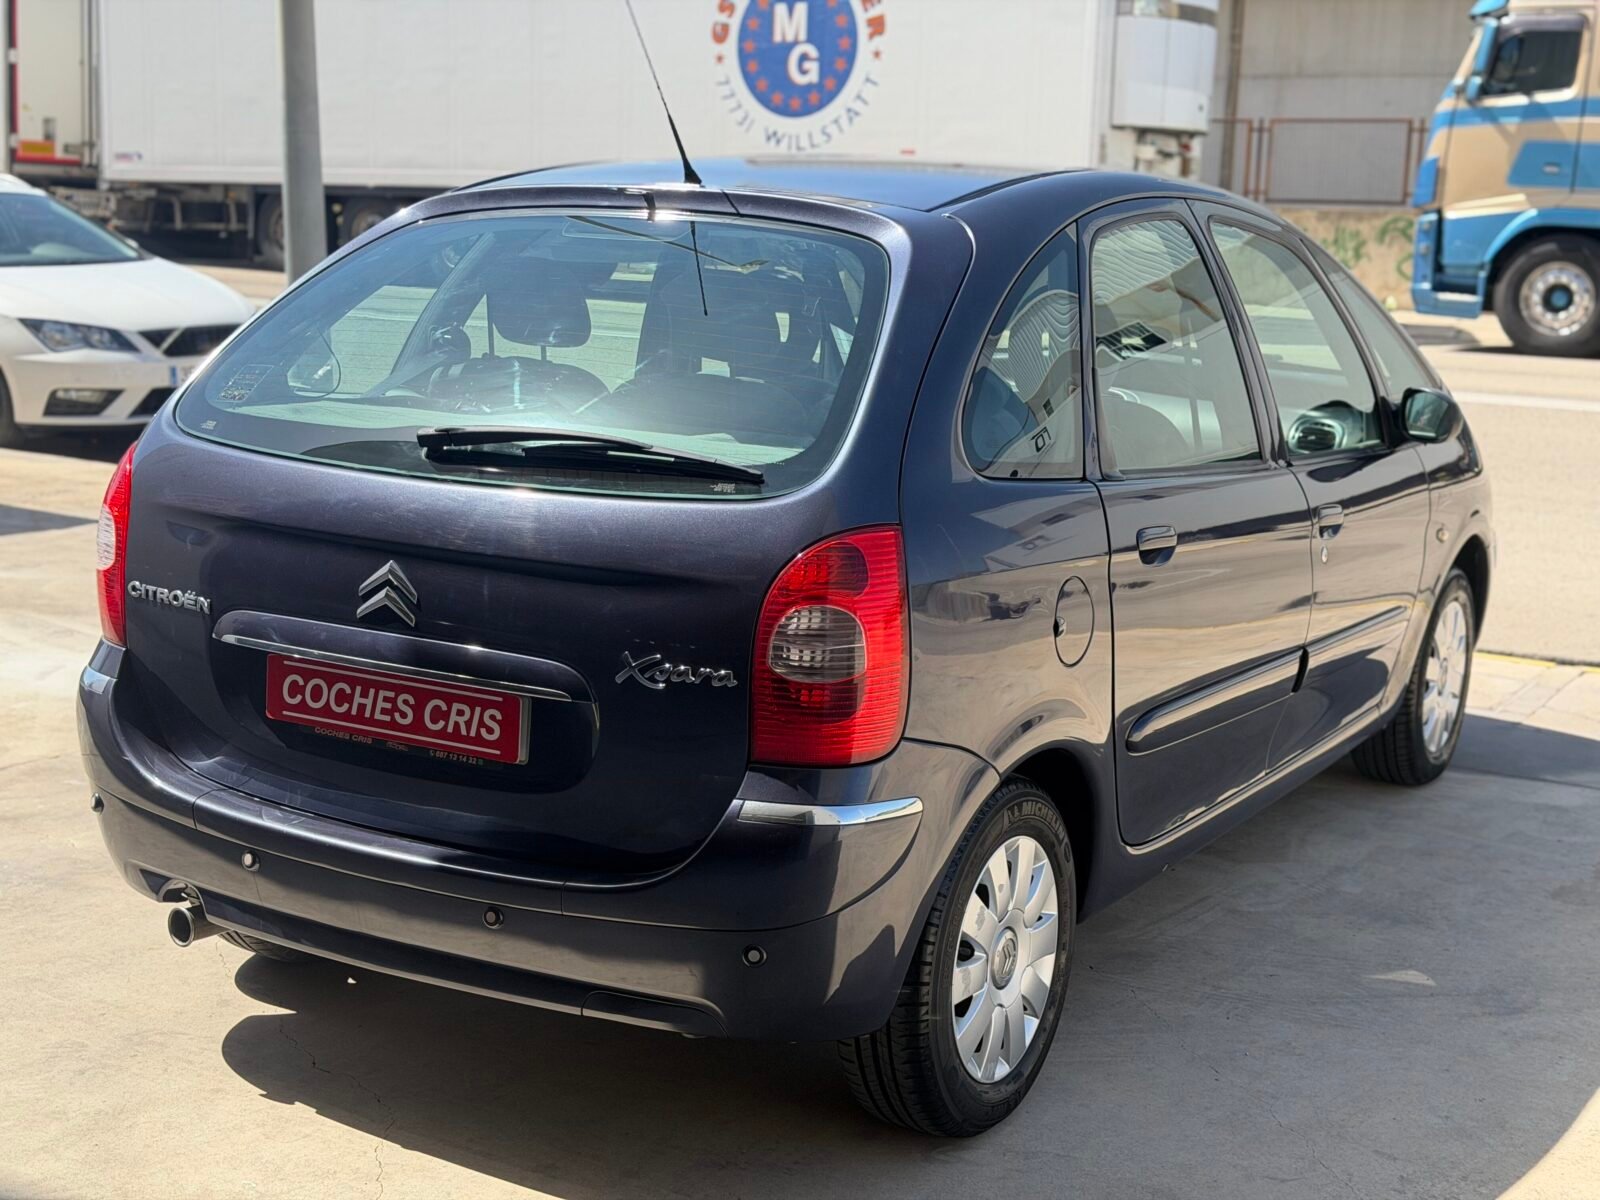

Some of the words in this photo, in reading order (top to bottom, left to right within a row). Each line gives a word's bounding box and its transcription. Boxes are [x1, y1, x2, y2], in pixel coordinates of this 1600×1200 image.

[127, 580, 211, 615] CITROËN
[615, 650, 738, 690] Xsara
[282, 673, 416, 726] COCHES
[423, 698, 503, 741] CRIS
[314, 726, 350, 740] COCHES
[1021, 800, 1066, 840] MICHELIN
